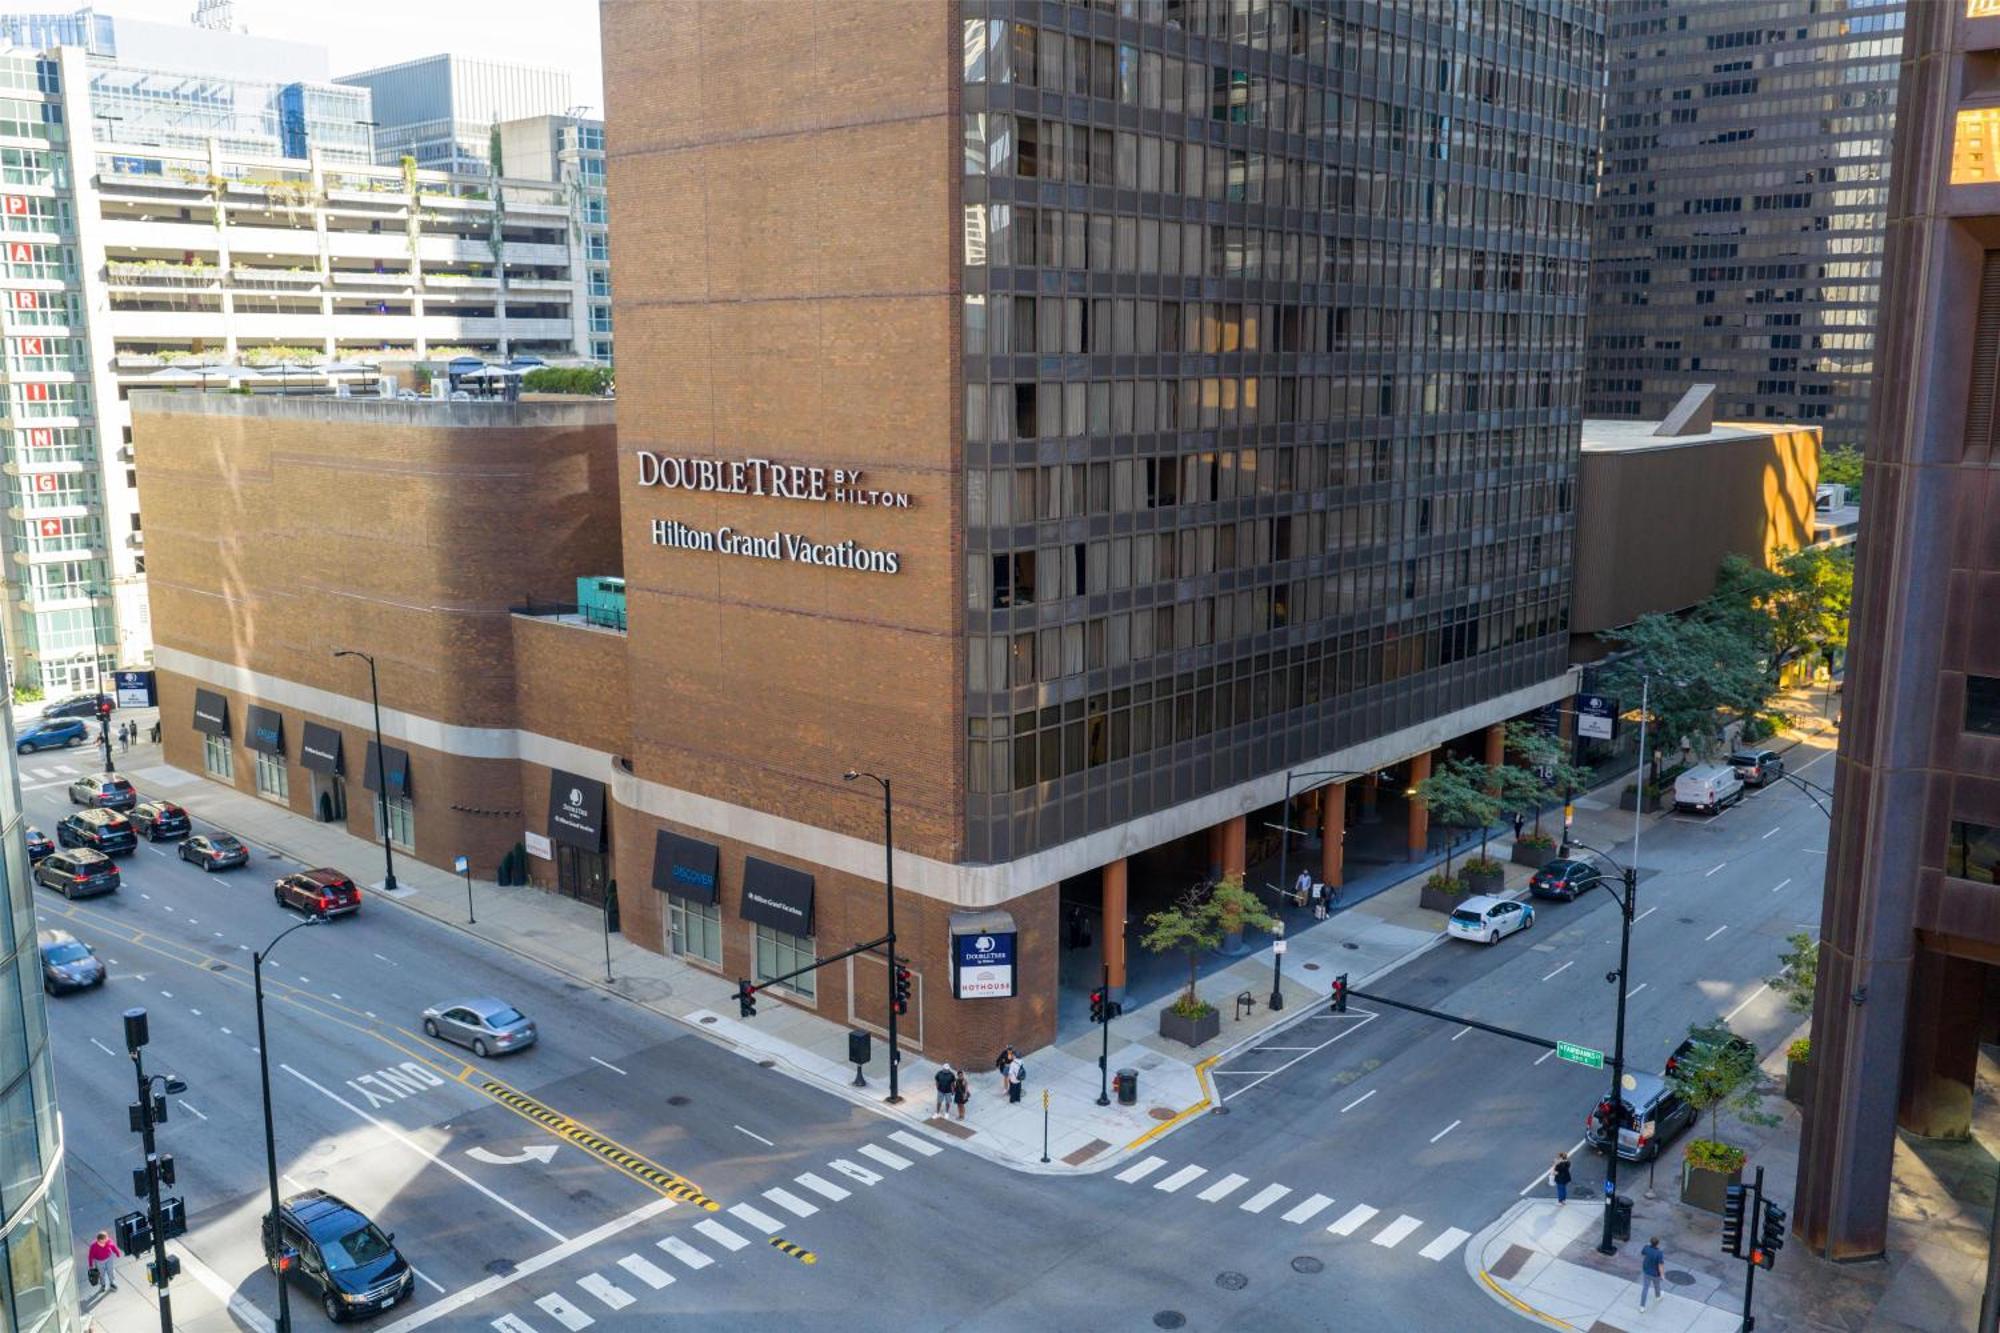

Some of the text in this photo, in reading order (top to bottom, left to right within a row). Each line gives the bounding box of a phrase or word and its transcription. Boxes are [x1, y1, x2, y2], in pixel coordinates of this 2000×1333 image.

[834, 469, 861, 485] BY
[835, 489, 909, 508] HILTON
[651, 519, 899, 574] Hilton Grand Vacations
[962, 983, 1010, 991] HOTHOUSE
[345, 1062, 445, 1109] ONLY
